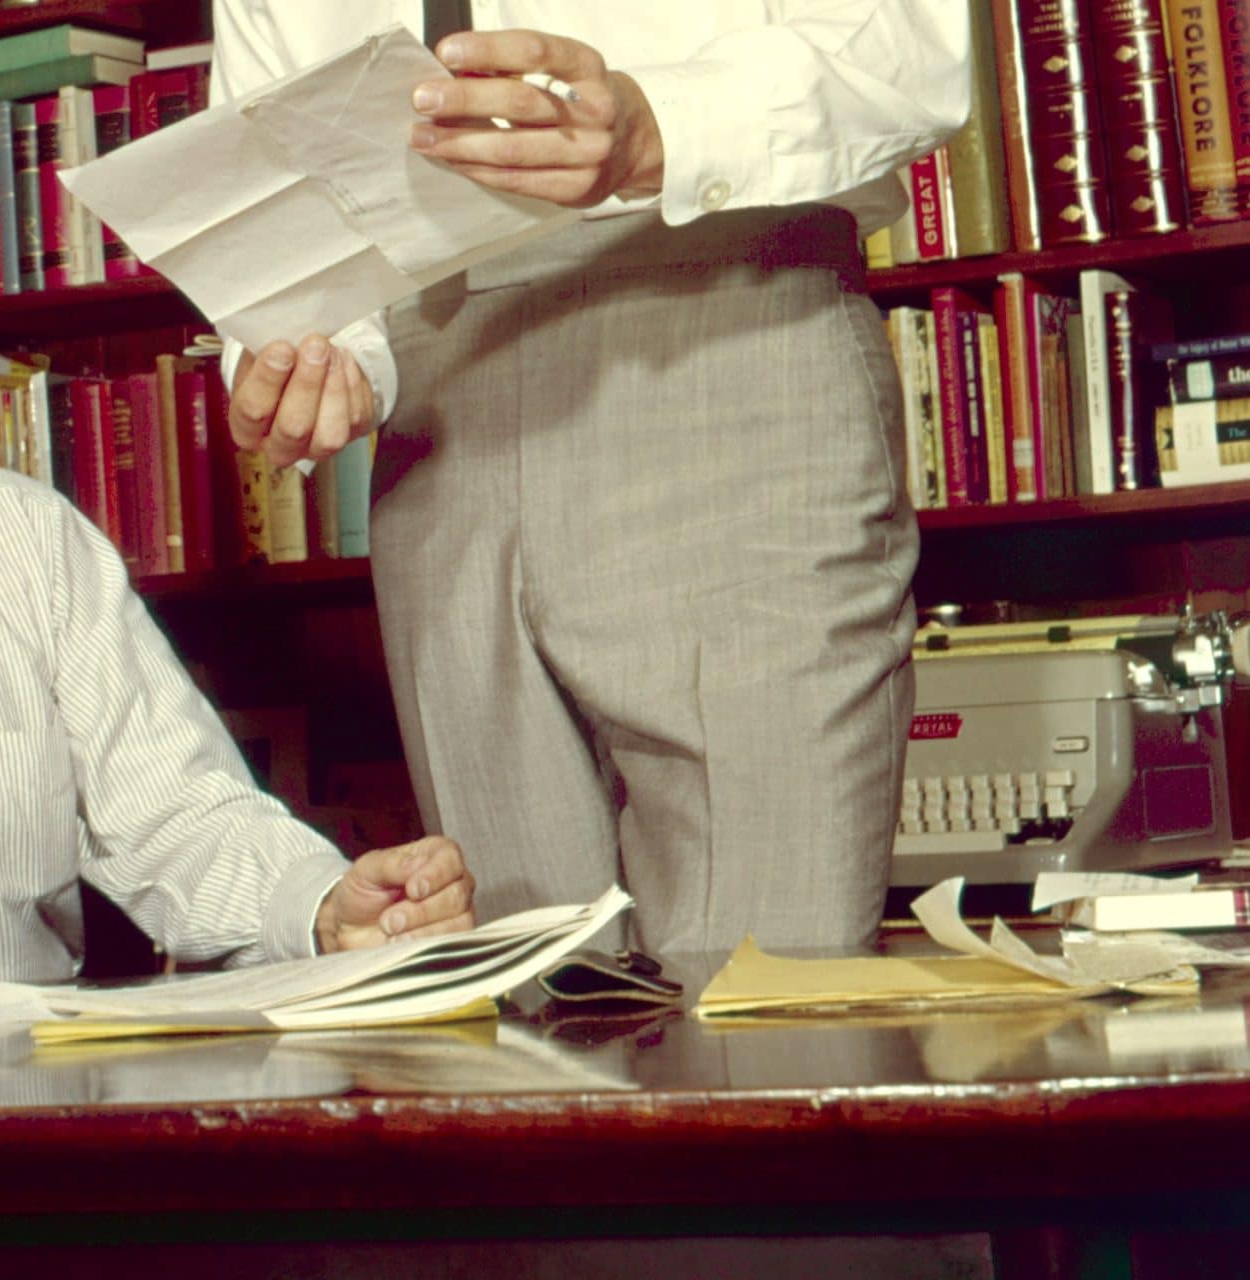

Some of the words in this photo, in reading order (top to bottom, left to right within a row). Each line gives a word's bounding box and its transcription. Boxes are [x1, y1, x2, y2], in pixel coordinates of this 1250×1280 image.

[1181, 6, 1216, 153] FOLKLORE
[918, 175, 938, 246] GREAT
[913, 722, 953, 735] ROYAL
